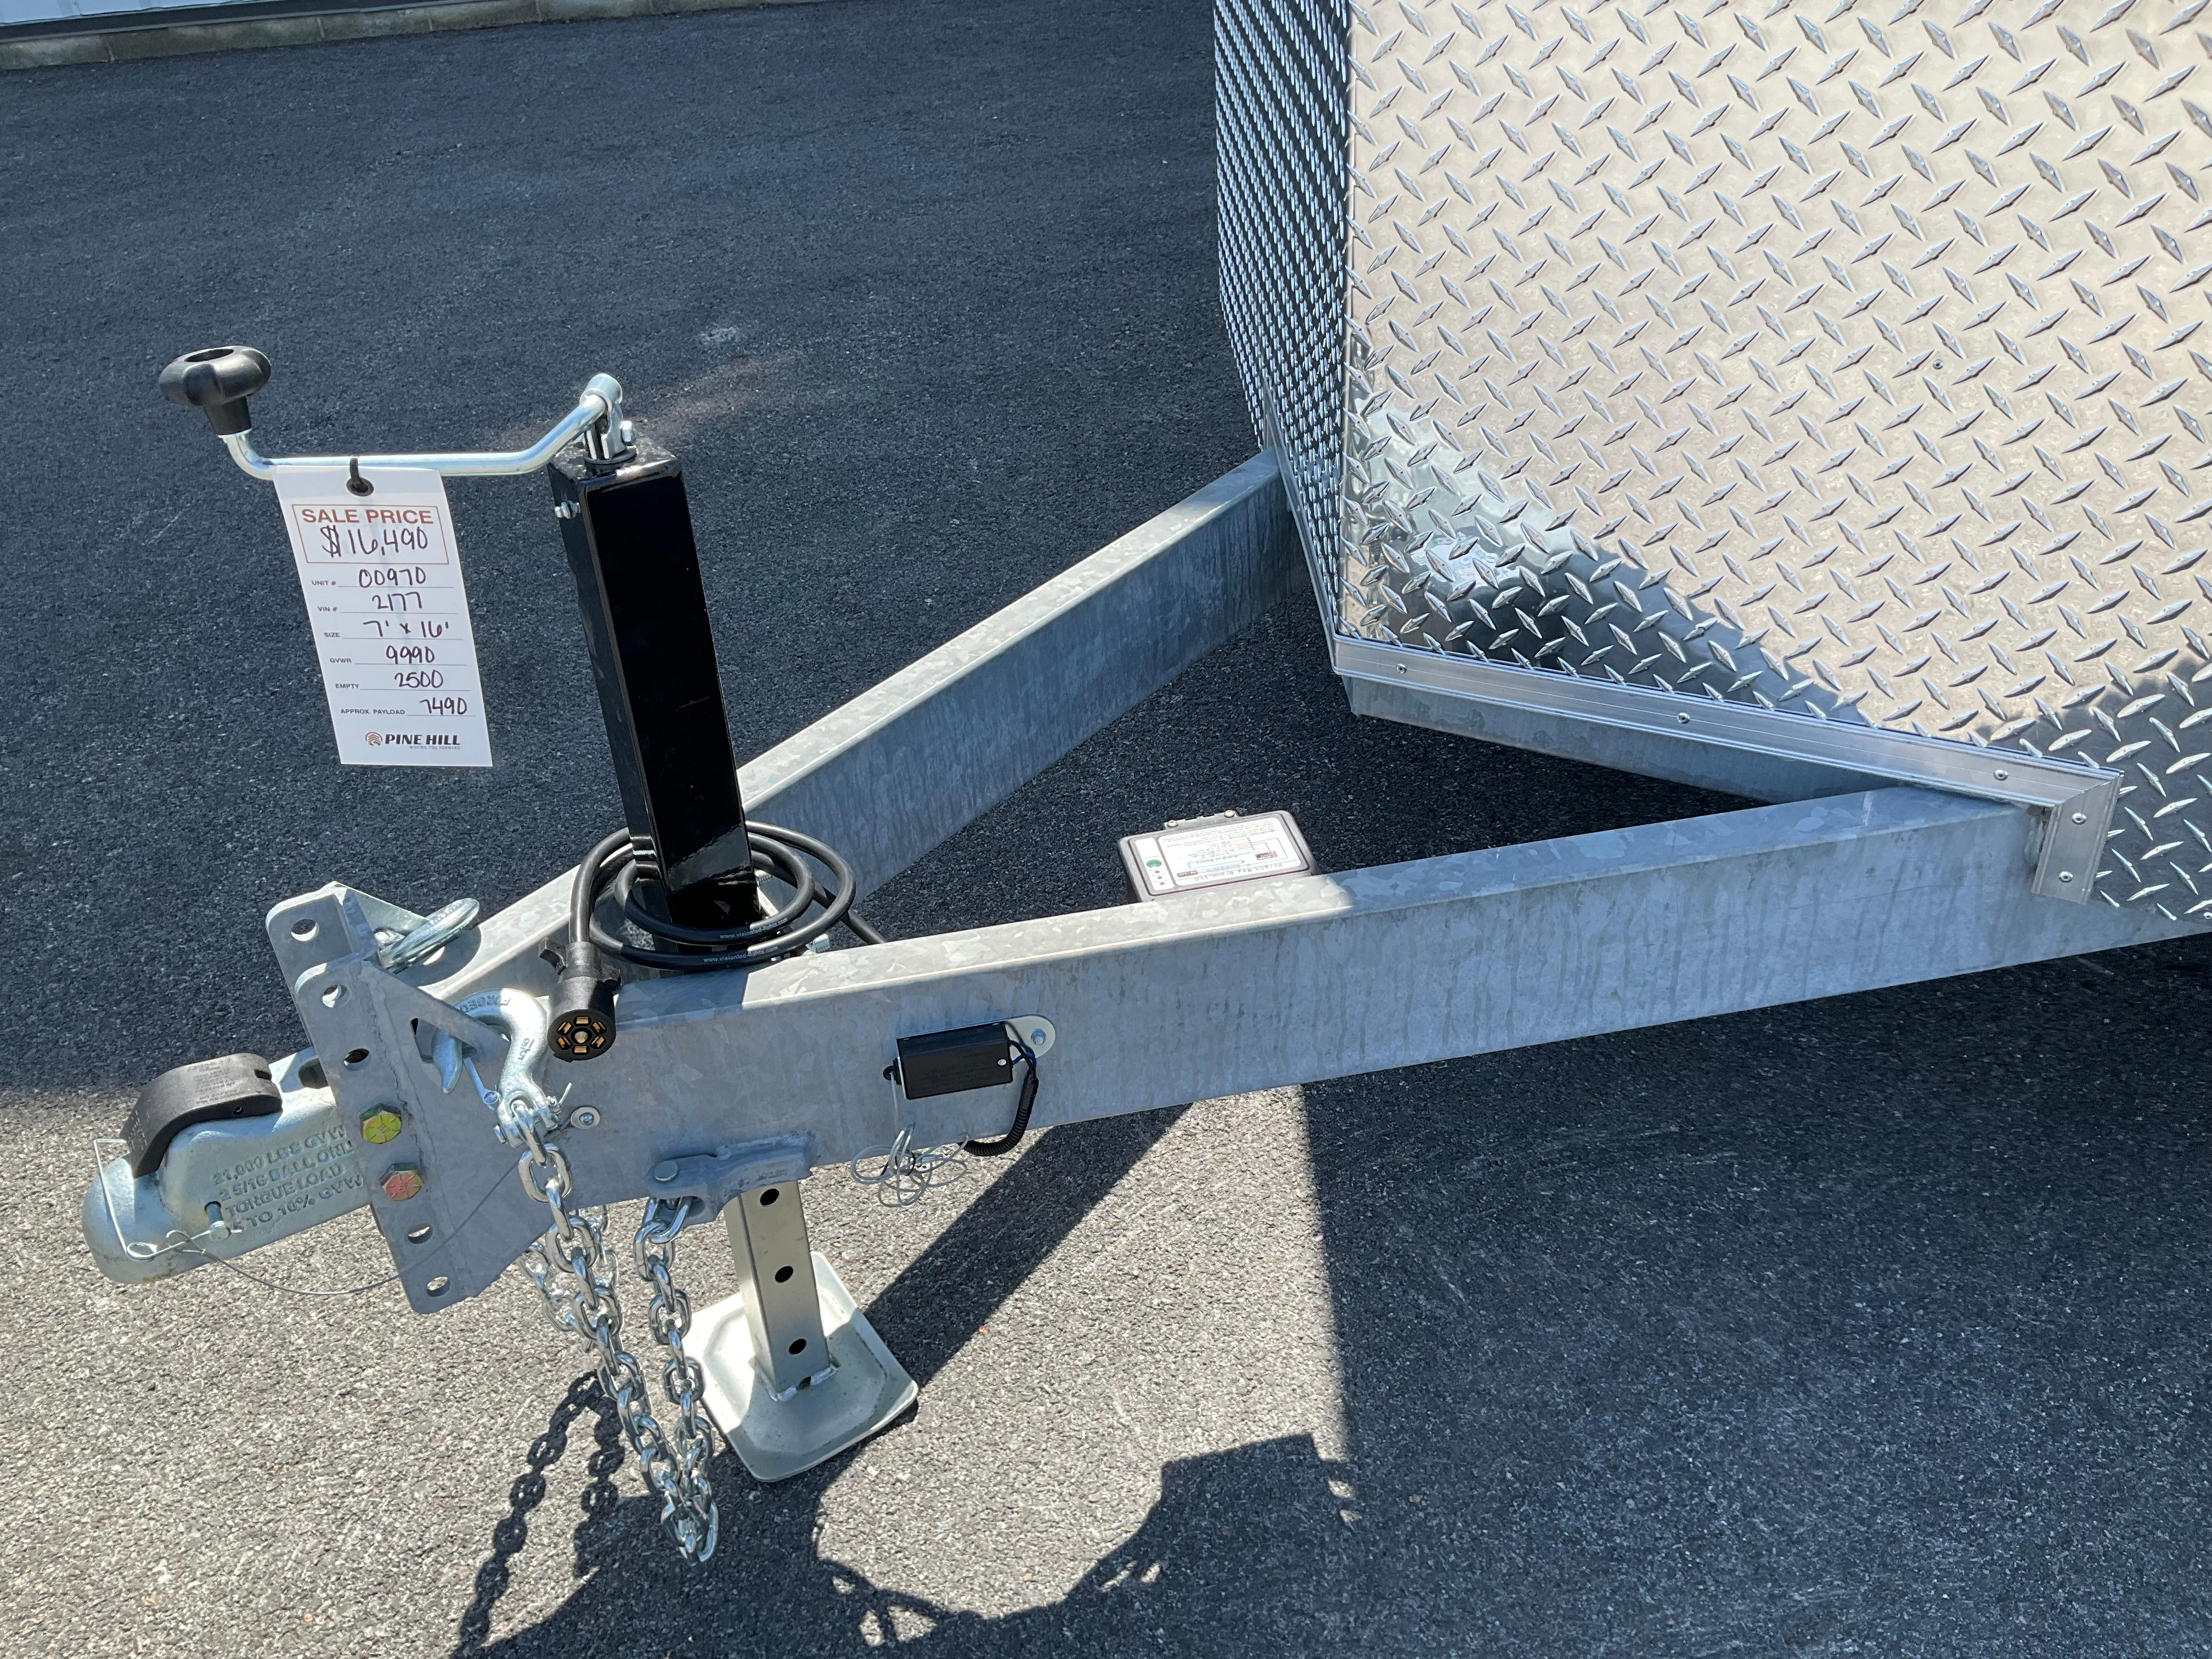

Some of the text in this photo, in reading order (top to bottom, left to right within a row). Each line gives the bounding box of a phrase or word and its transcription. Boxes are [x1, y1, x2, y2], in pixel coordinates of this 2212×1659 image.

[301, 509, 434, 524] SALE PRICE
[320, 524, 428, 558] $16,490
[359, 566, 426, 588] 00970
[371, 591, 422, 611] 2177
[363, 620, 390, 637] 7'
[421, 620, 449, 638] 16'
[386, 645, 435, 665] 9990
[394, 669, 444, 689] 2500
[419, 697, 467, 715] 7490
[385, 734, 461, 745] PINE HILL
[719, 917, 788, 939] www.visionled-lights.com
[703, 946, 778, 962] www.visionled-lights.com
[459, 995, 512, 1014] FORGED
[305, 1125, 346, 1148] GVW
[219, 1189, 231, 1201] 2
[269, 1158, 315, 1181] BALL
[225, 1163, 345, 1217] TONGUE LOAD
[246, 1211, 273, 1228] TO
[277, 1194, 316, 1216] 10%
[319, 1172, 364, 1199] GVW
